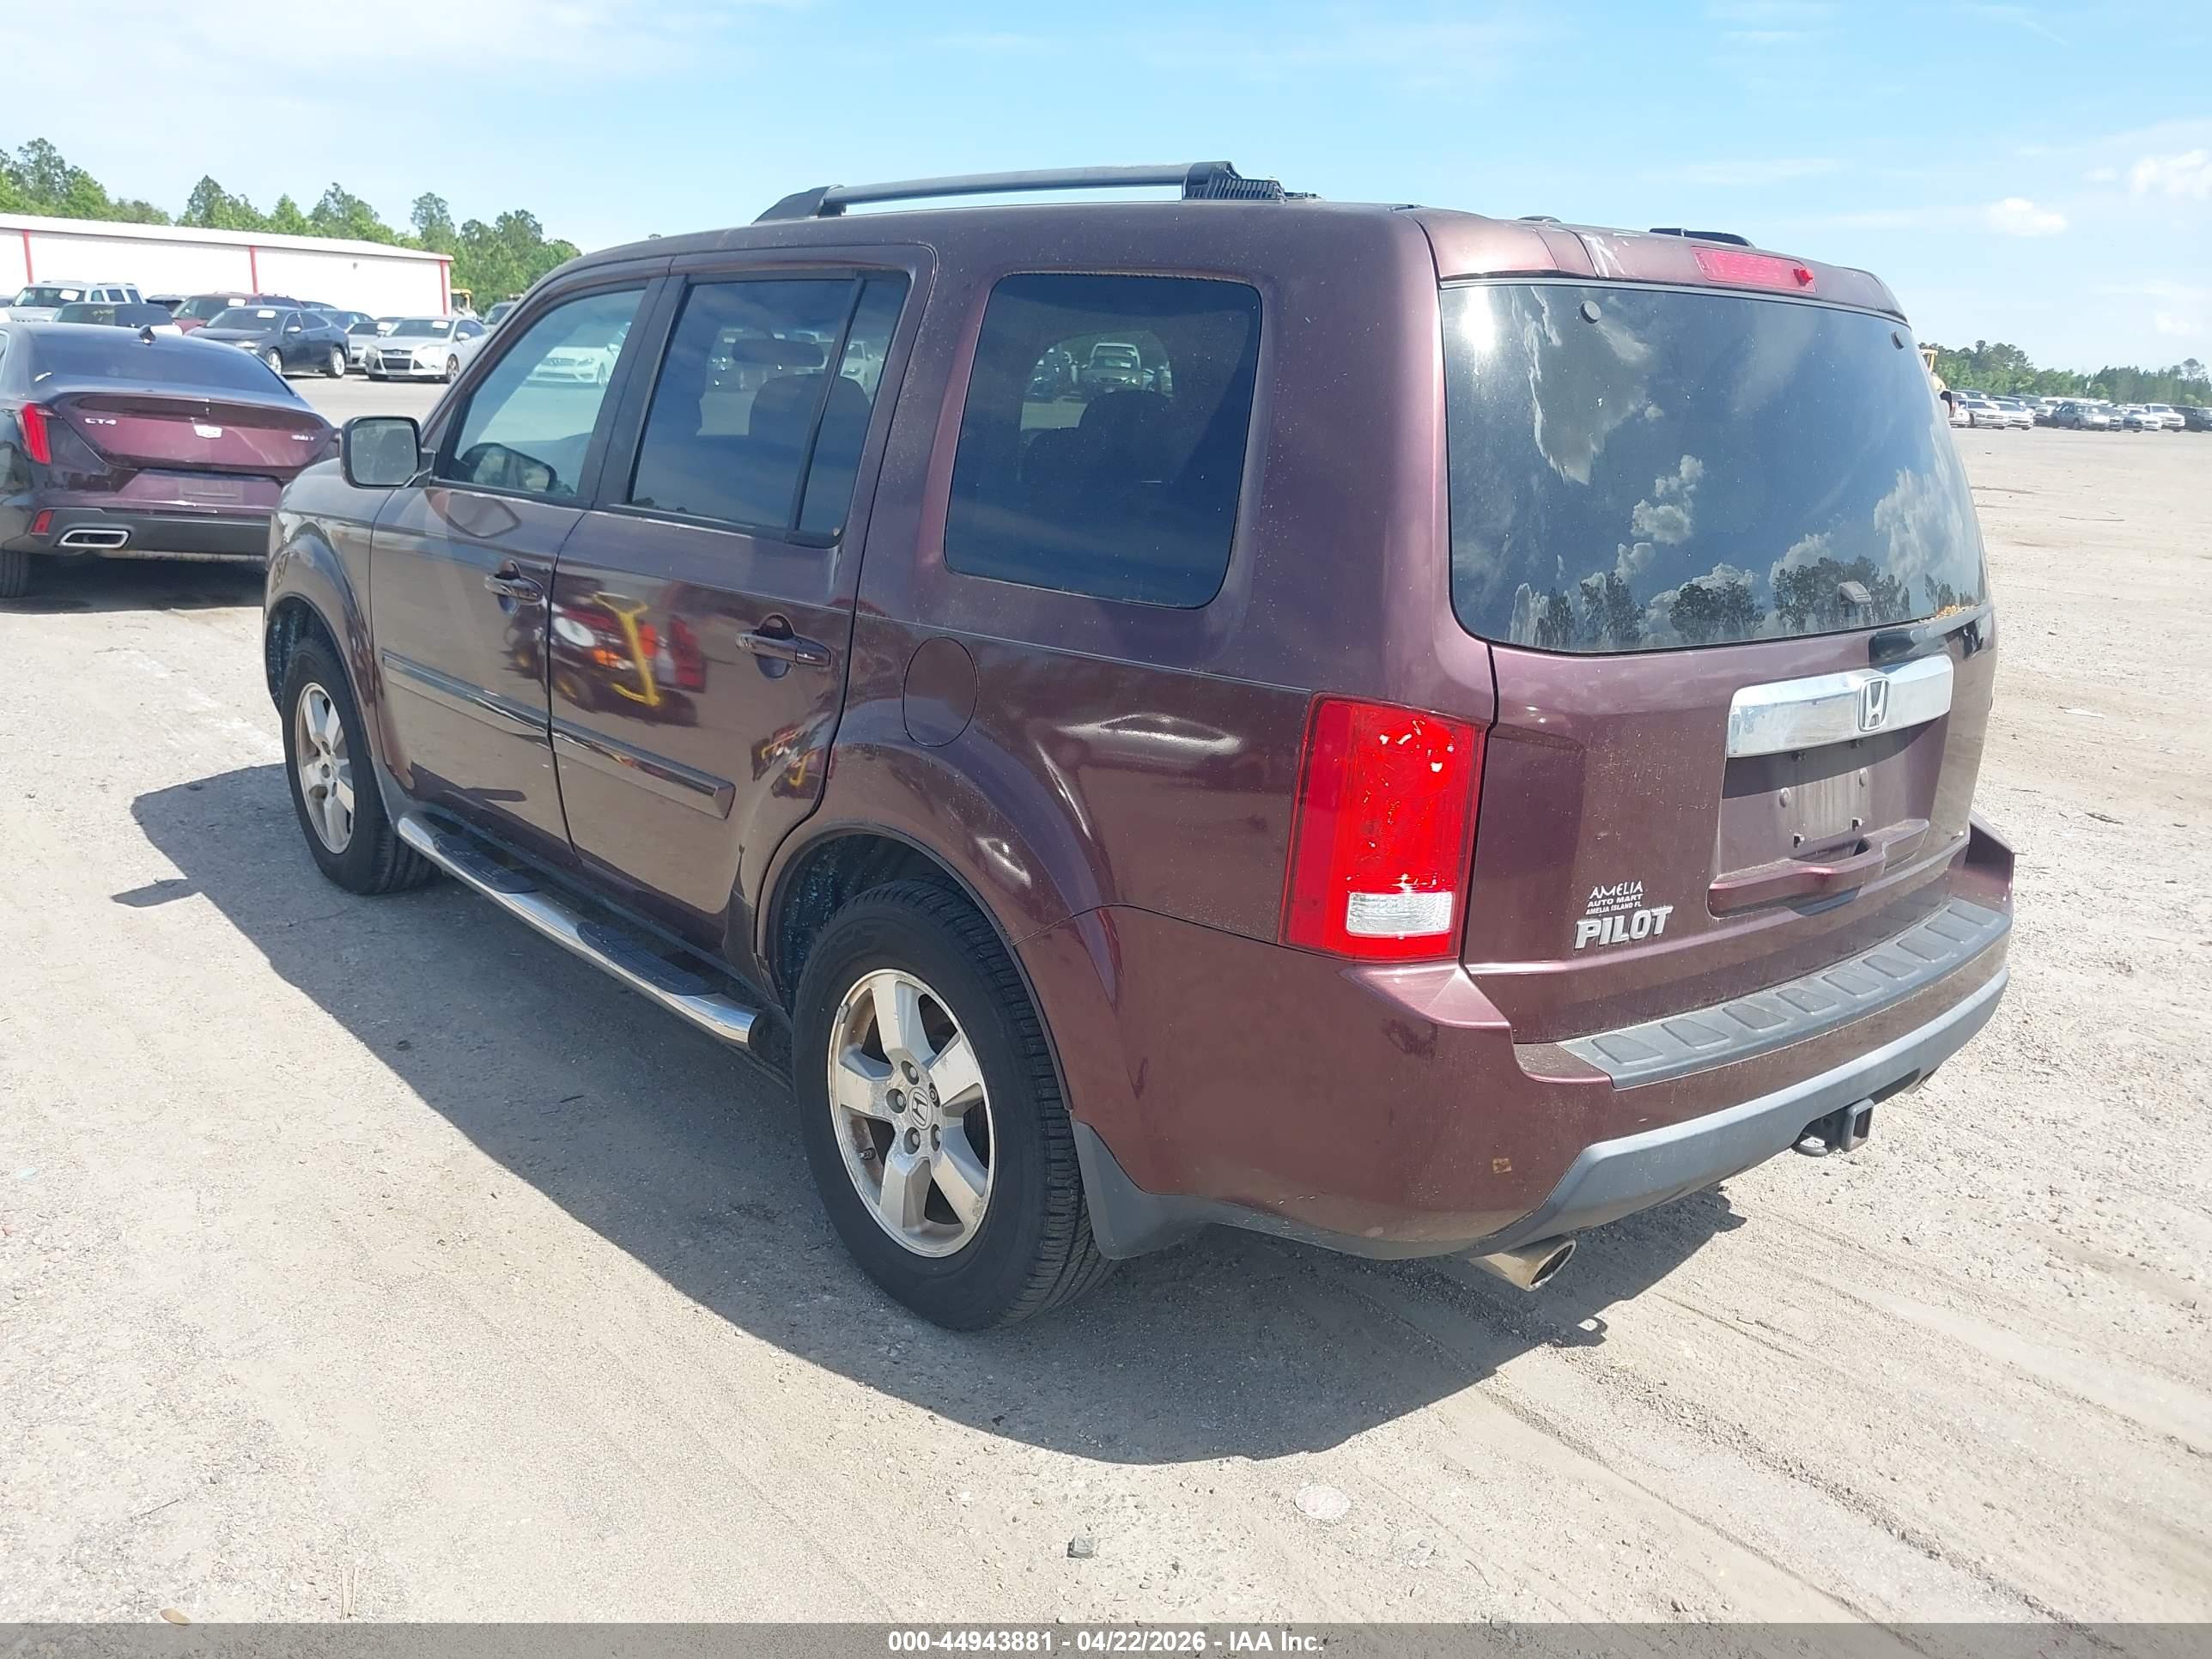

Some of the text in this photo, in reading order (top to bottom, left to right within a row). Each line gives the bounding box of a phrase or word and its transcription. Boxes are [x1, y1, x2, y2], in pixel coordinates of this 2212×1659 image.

[1589, 880, 1644, 899] AMELIA
[1585, 906, 1610, 915] AMELIA
[1611, 902, 1633, 911] ISLAND
[1587, 893, 1644, 908] AUTO MART
[1574, 905, 1674, 950] PILOT
